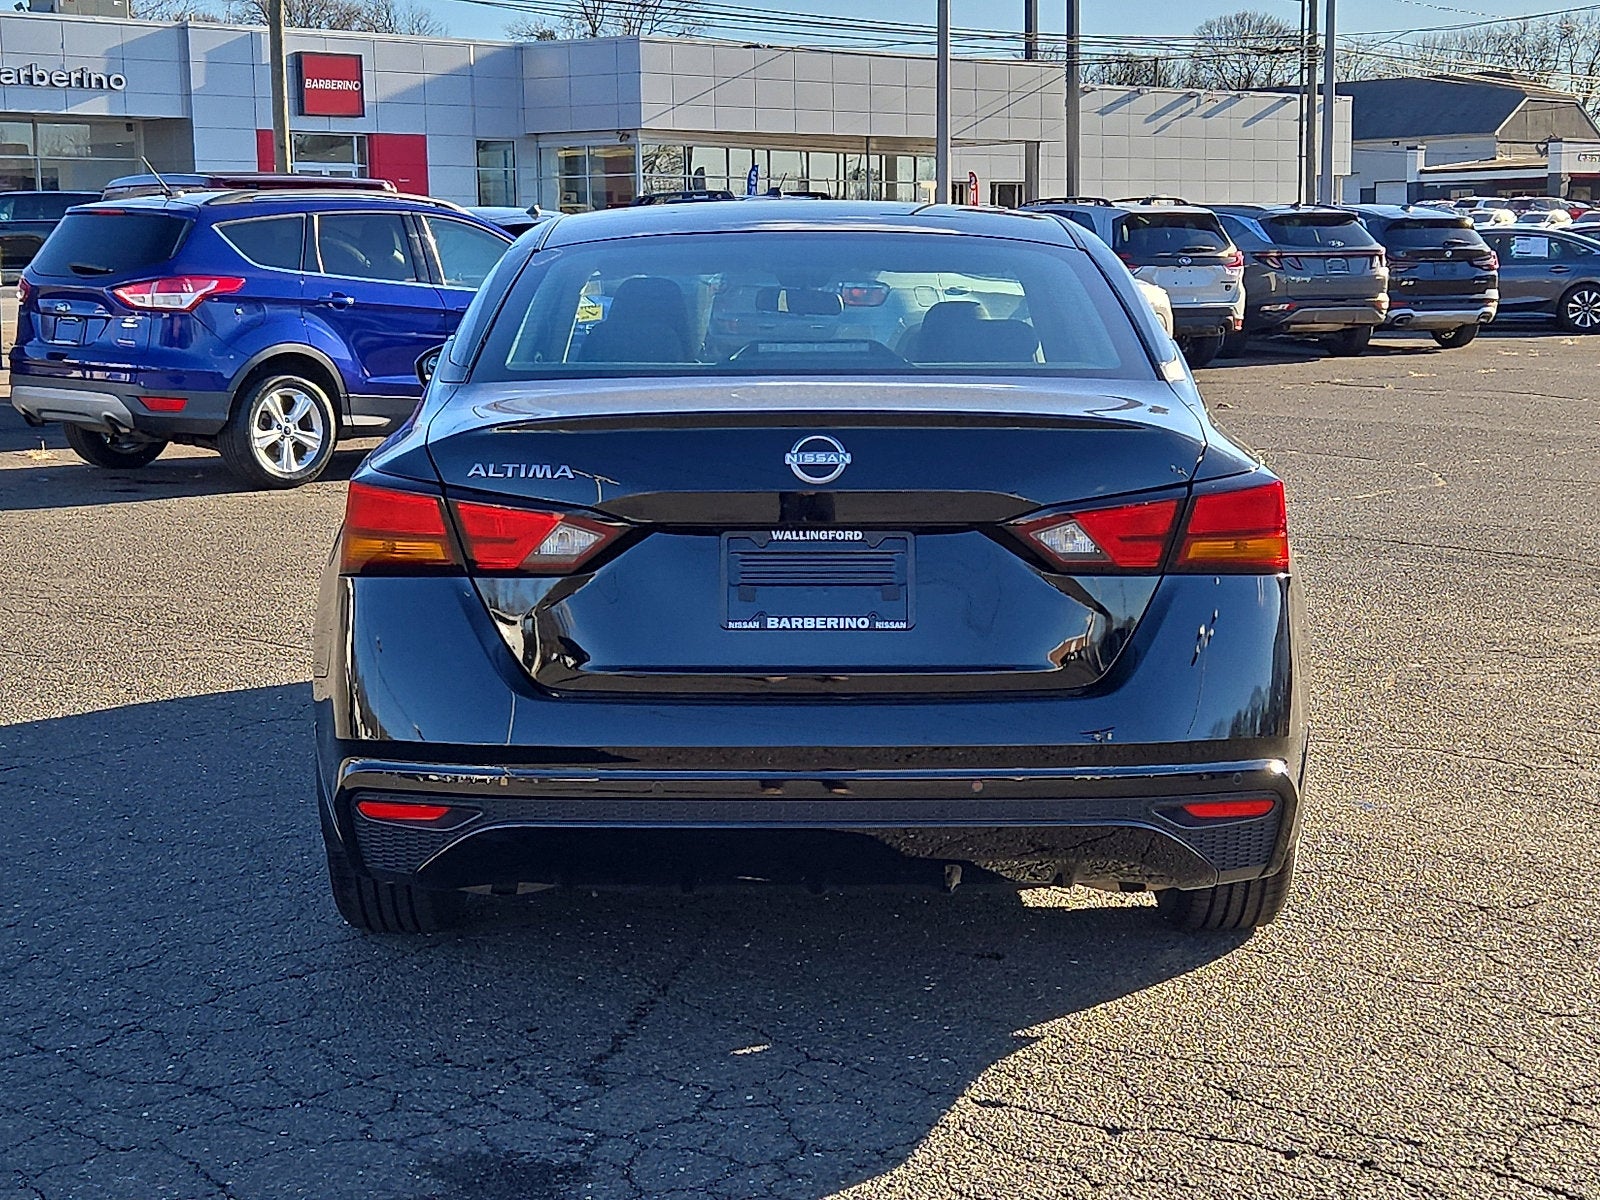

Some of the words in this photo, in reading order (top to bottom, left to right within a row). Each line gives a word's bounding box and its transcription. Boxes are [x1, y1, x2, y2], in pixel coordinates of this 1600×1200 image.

[304, 78, 361, 91] BARBERINO
[785, 452, 851, 464] NISSAN
[466, 463, 575, 479] ALTIMA
[771, 530, 863, 541] WALLINGFORD
[728, 621, 760, 629] NISSAN
[766, 617, 870, 629] BARBERINO
[875, 621, 907, 629] NISSAN
